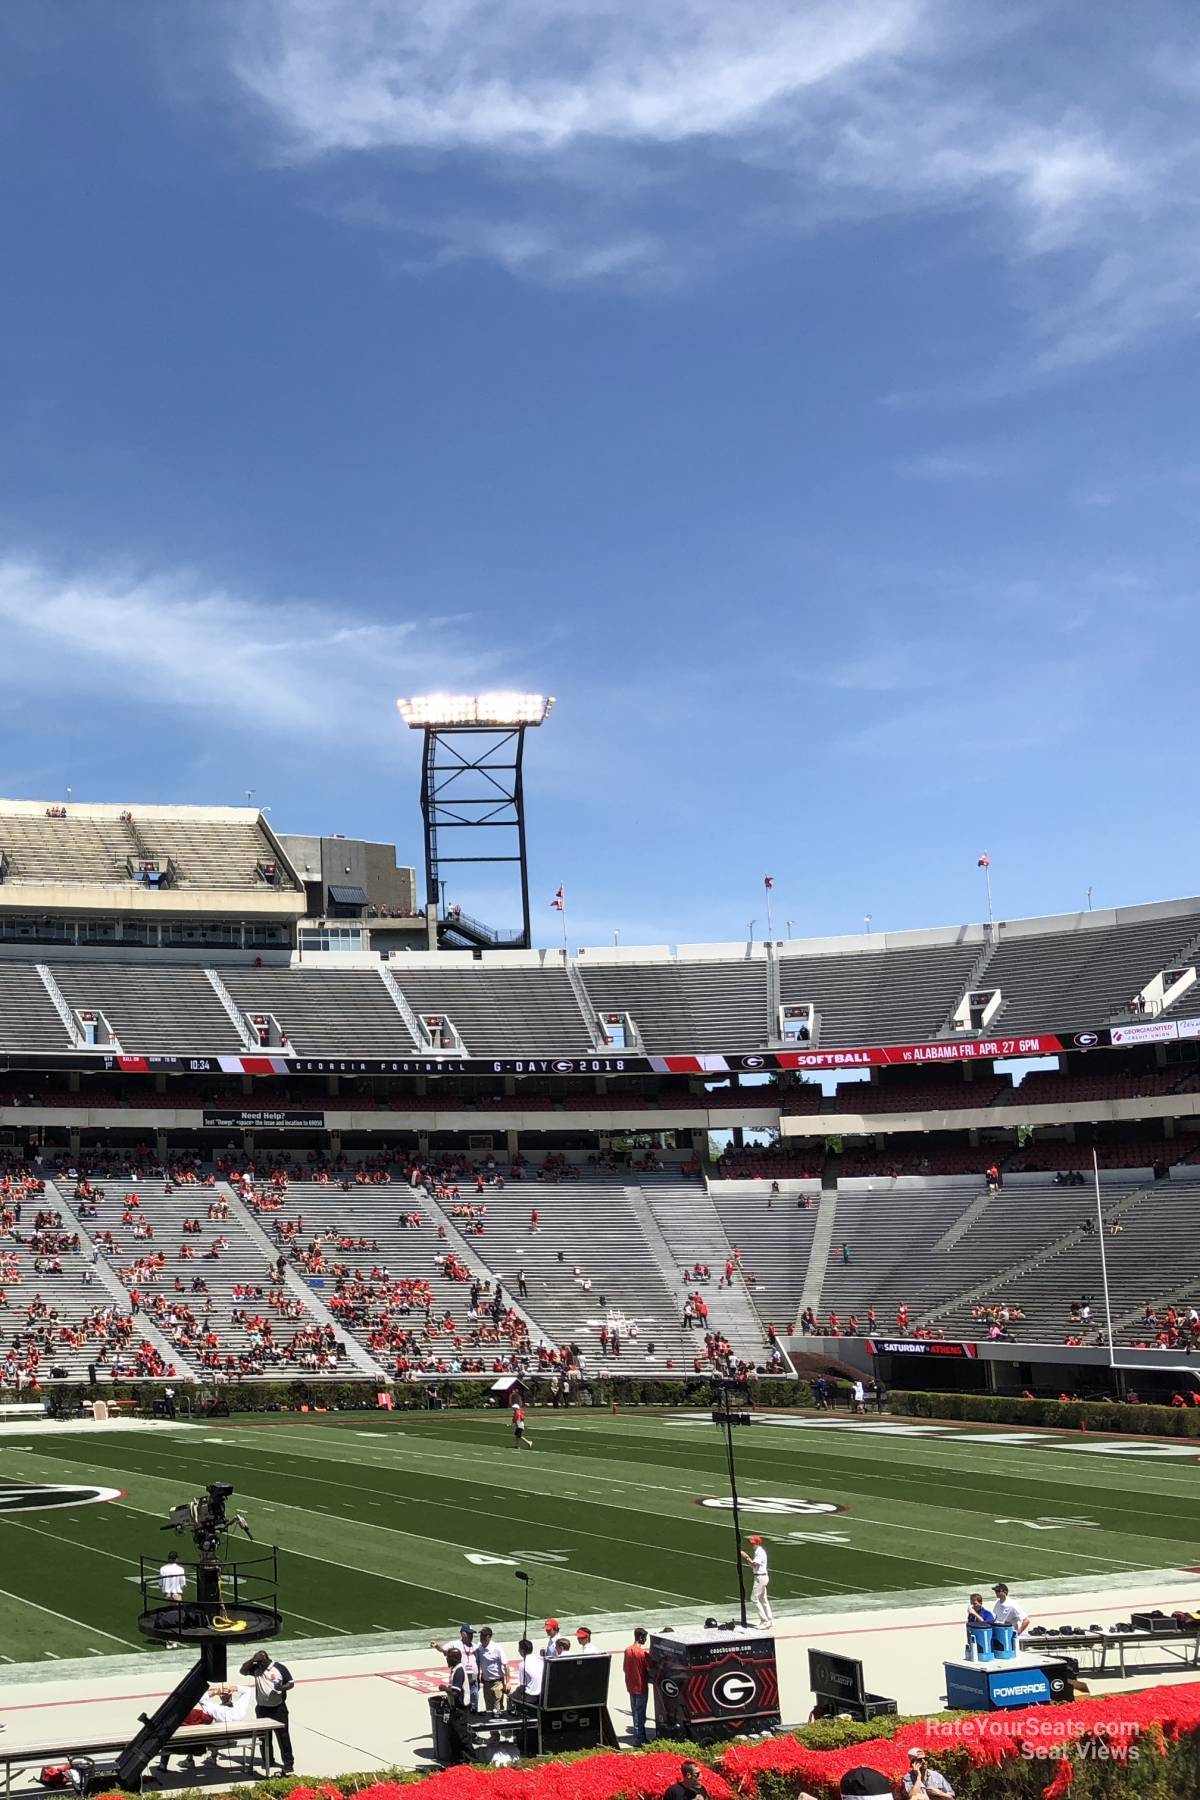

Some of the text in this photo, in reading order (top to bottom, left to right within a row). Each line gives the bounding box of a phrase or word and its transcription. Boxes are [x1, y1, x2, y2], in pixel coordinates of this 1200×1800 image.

[913, 1047, 958, 1059] ALABAMA
[960, 1046, 977, 1056] FRI.
[979, 1043, 1000, 1055] APR.
[1002, 1042, 1015, 1053] 27
[1020, 1039, 1039, 1051] 6PM
[797, 1053, 871, 1065] SOFTBALL
[190, 1060, 210, 1070] 10:34
[380, 1063, 465, 1071] FOOTBALL
[493, 1061, 548, 1072] G-DAY
[579, 1060, 625, 1071] 2018
[263, 1113, 286, 1121] Help?
[884, 1343, 926, 1353] SATURDAY
[930, 1345, 963, 1354] ATHENS
[463, 1550, 570, 1566] 40
[710, 1645, 752, 1654] coachcomm.com
[993, 1683, 1046, 1697] POWERADE
